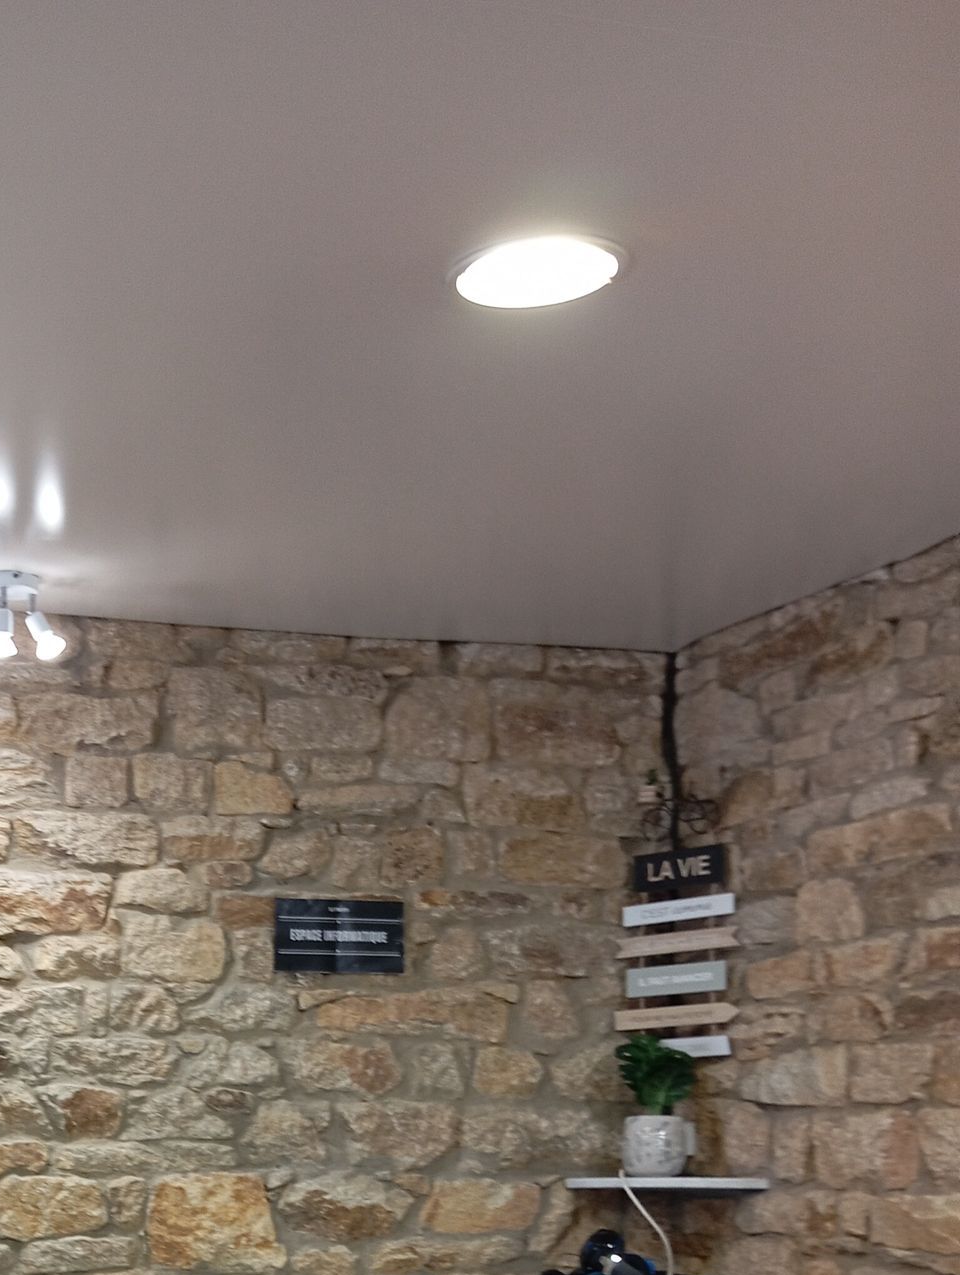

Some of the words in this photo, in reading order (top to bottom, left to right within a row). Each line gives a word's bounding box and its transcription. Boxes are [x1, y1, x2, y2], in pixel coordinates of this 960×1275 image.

[646, 860, 675, 882] LA
[676, 854, 712, 878] VIE
[289, 928, 323, 942] ESPACE
[323, 929, 389, 944] INFORMATIQUE
